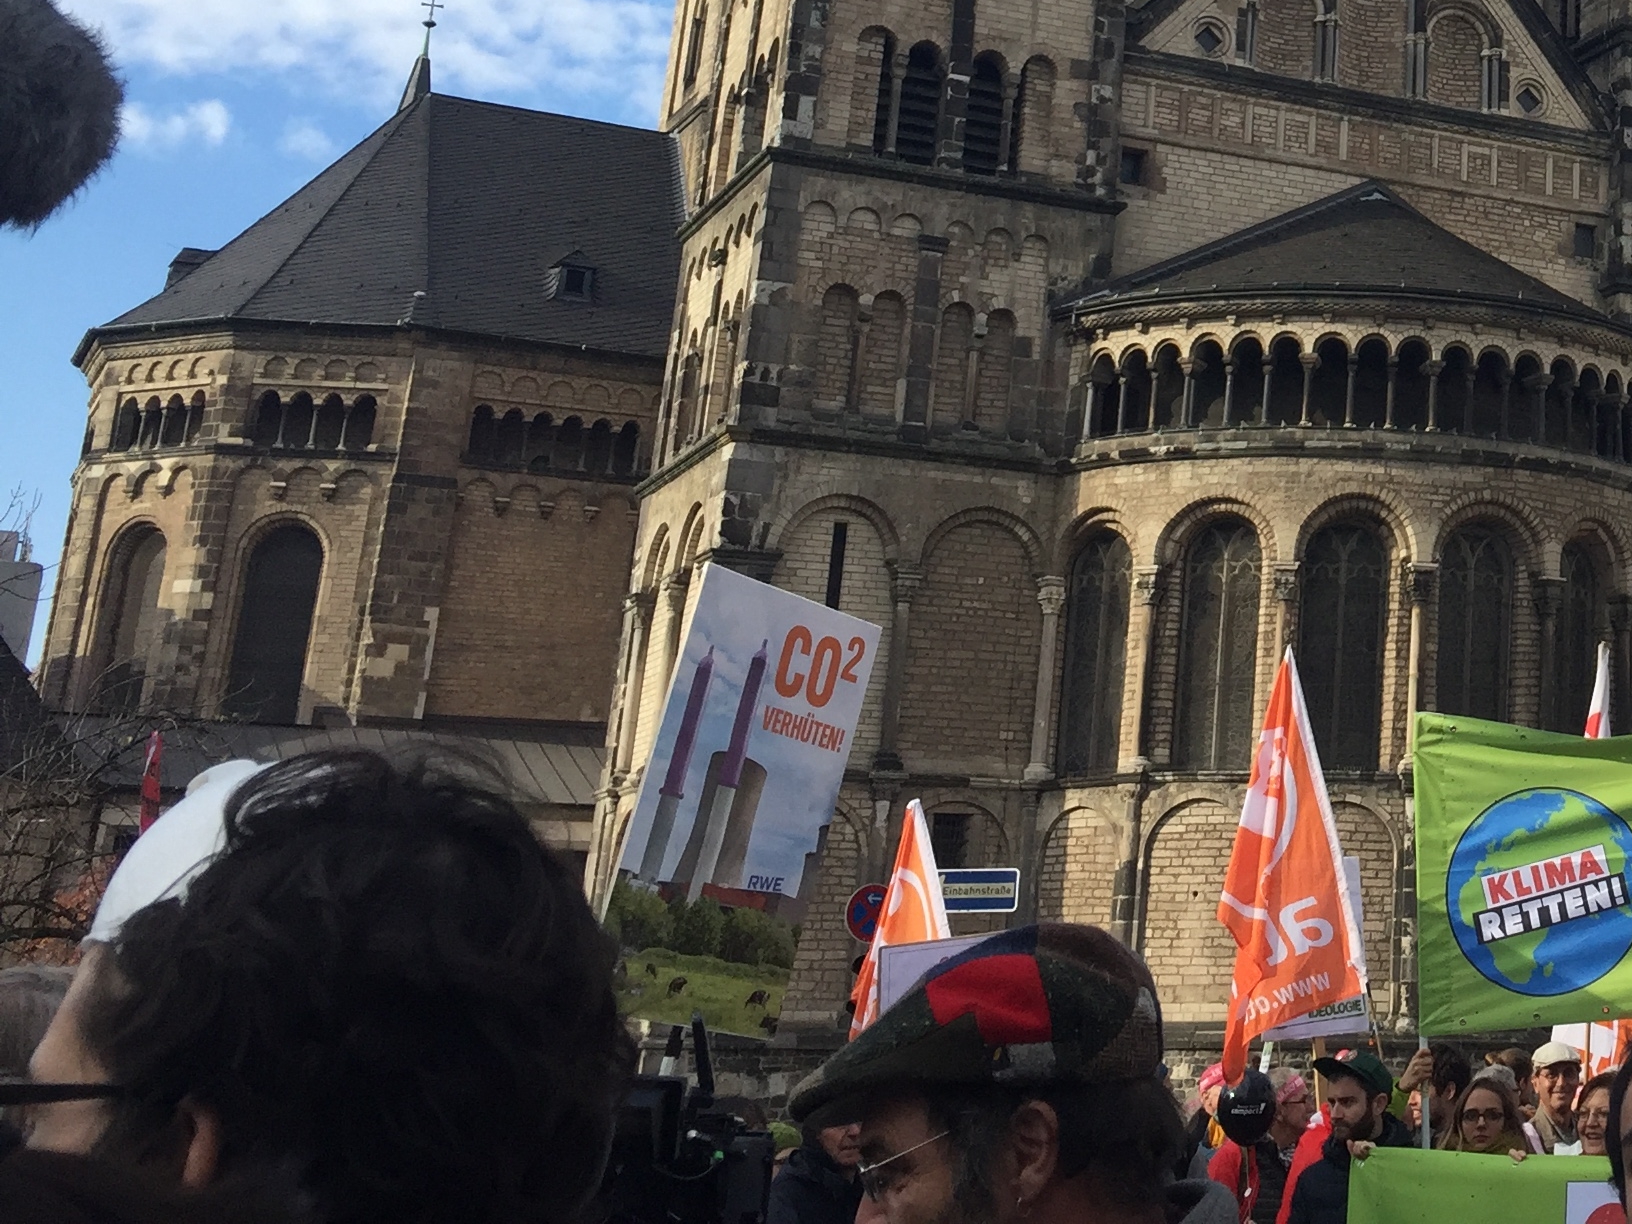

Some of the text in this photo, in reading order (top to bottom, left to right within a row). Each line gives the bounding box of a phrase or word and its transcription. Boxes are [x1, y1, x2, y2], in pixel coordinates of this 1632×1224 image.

[762, 704, 846, 753] VERHÜTEN!
[747, 875, 785, 892] RWE
[942, 885, 1011, 896] Einbahnstraße
[1486, 850, 1604, 905] KLIMA
[1478, 877, 1625, 942] RETTEN!
